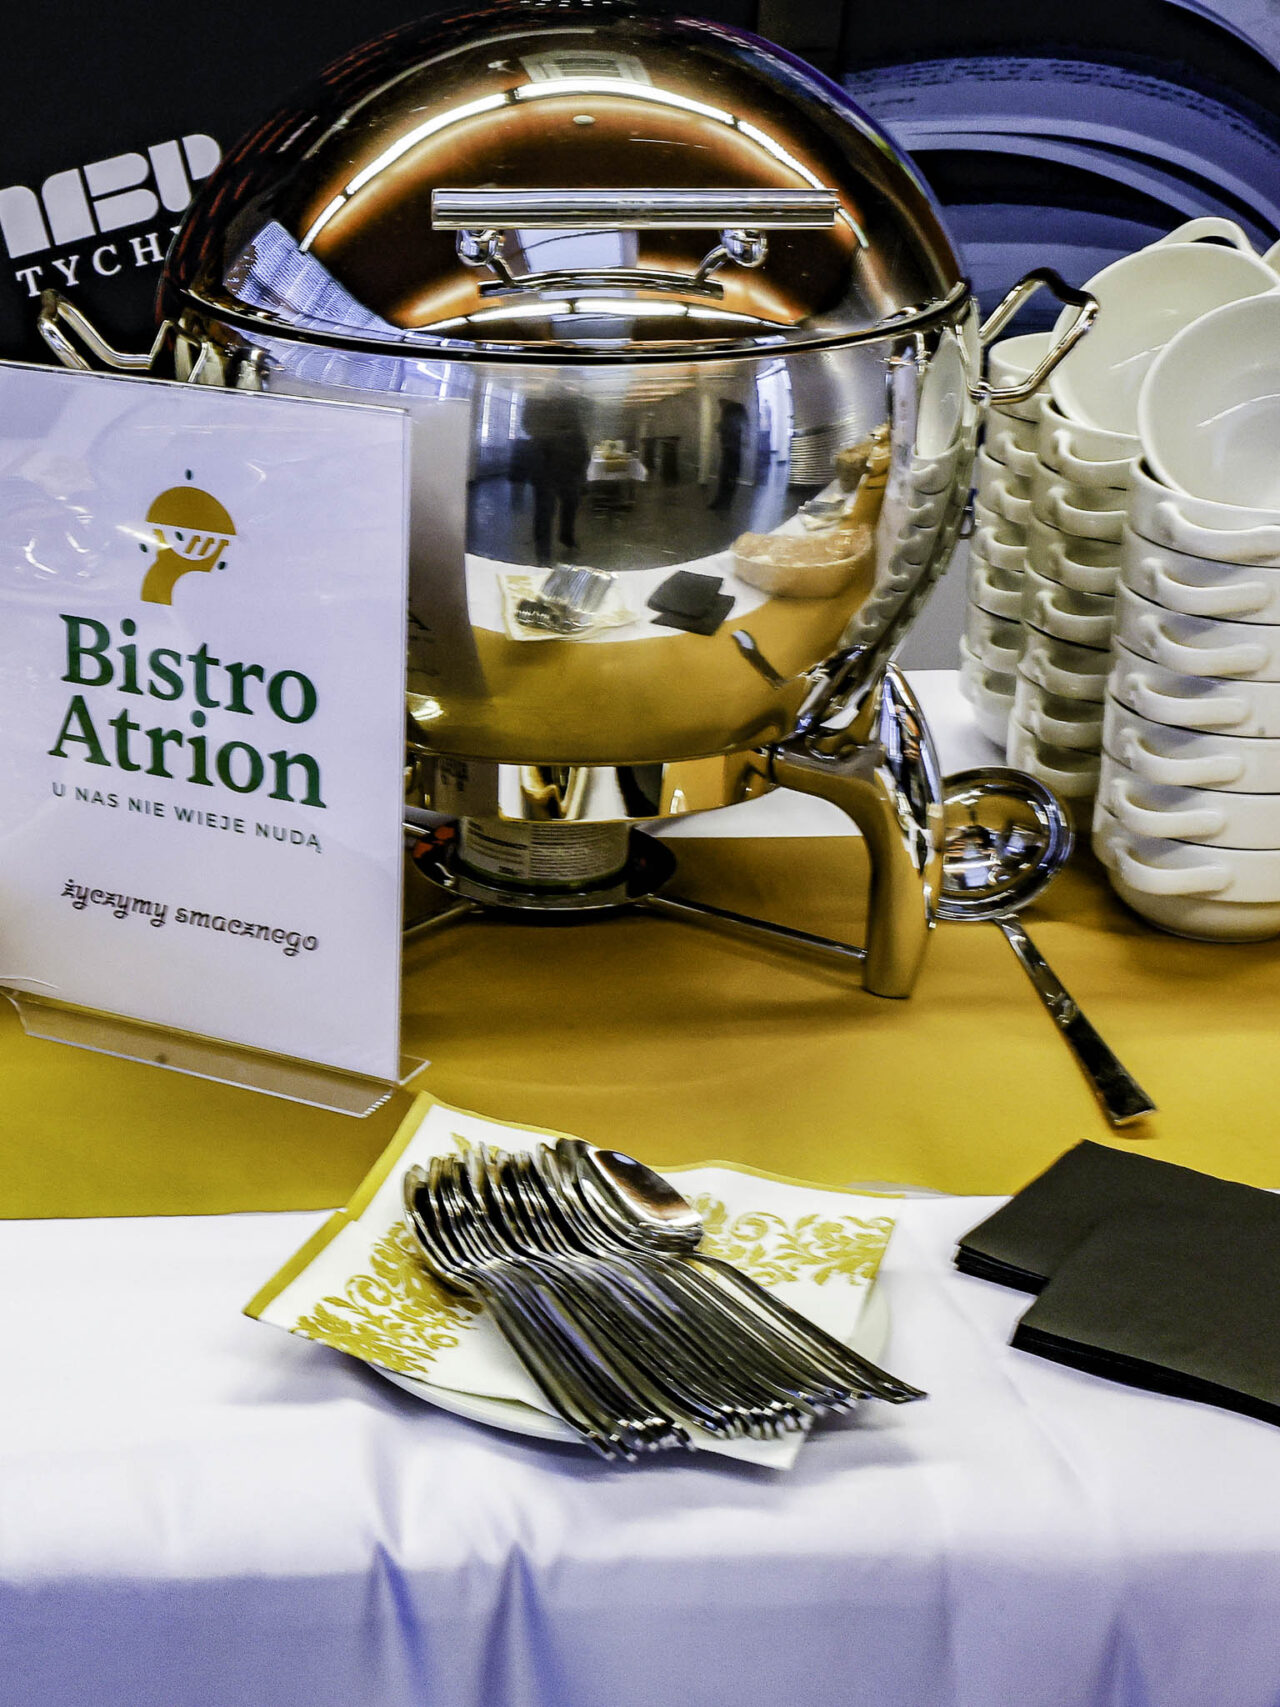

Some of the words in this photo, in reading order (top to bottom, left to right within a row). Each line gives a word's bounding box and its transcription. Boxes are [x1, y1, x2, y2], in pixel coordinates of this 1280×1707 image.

[15, 226, 183, 297] TYCH
[59, 614, 318, 724] Bistro
[47, 695, 327, 809] Atrion
[52, 782, 66, 797] U
[75, 786, 119, 808] NAS
[128, 797, 165, 818] NIE
[174, 806, 246, 834] WIEJE
[255, 822, 322, 854] NUDĄ
[61, 879, 168, 928] życzymy
[174, 907, 319, 957] smacznego
